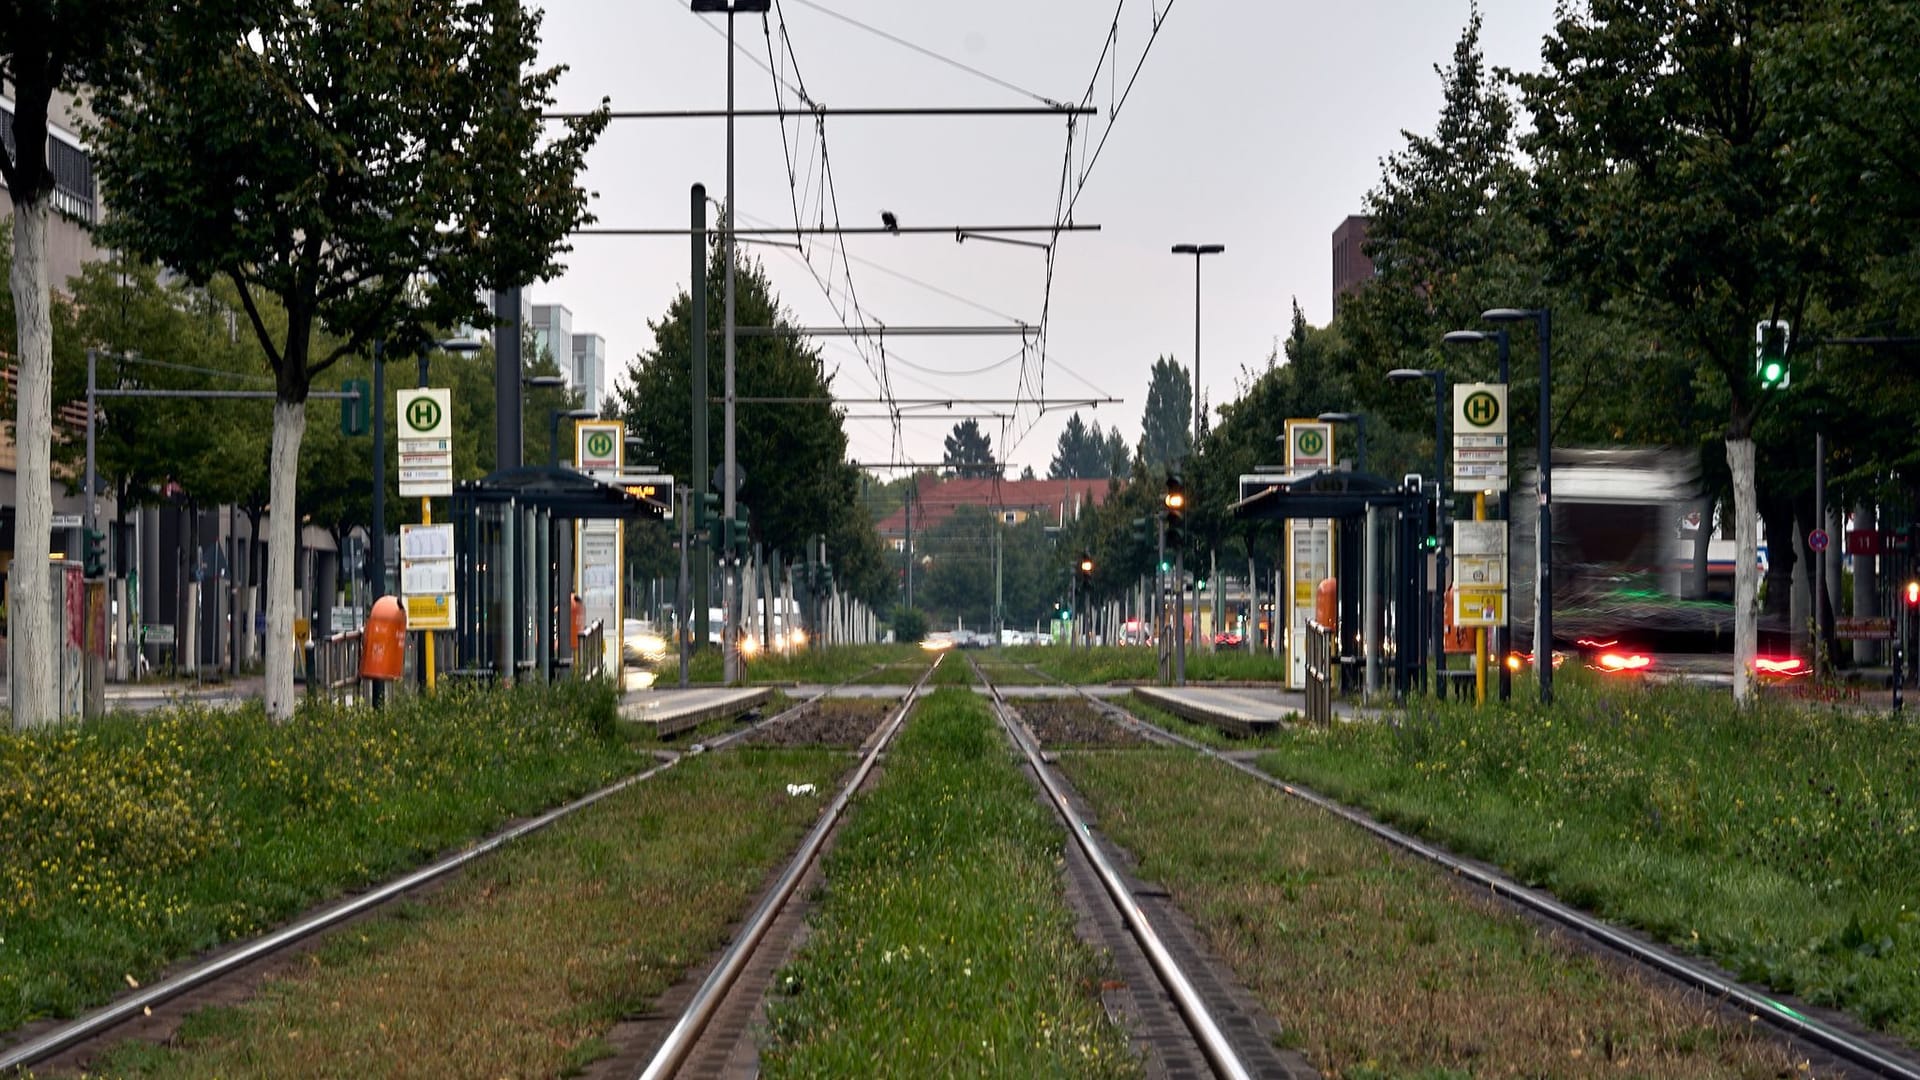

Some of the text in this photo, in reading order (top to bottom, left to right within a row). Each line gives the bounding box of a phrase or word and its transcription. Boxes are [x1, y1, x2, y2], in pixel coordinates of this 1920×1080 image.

[415, 404, 432, 424] H
[1473, 398, 1490, 418] H
[594, 438, 606, 451] H
[1305, 437, 1316, 449] H
